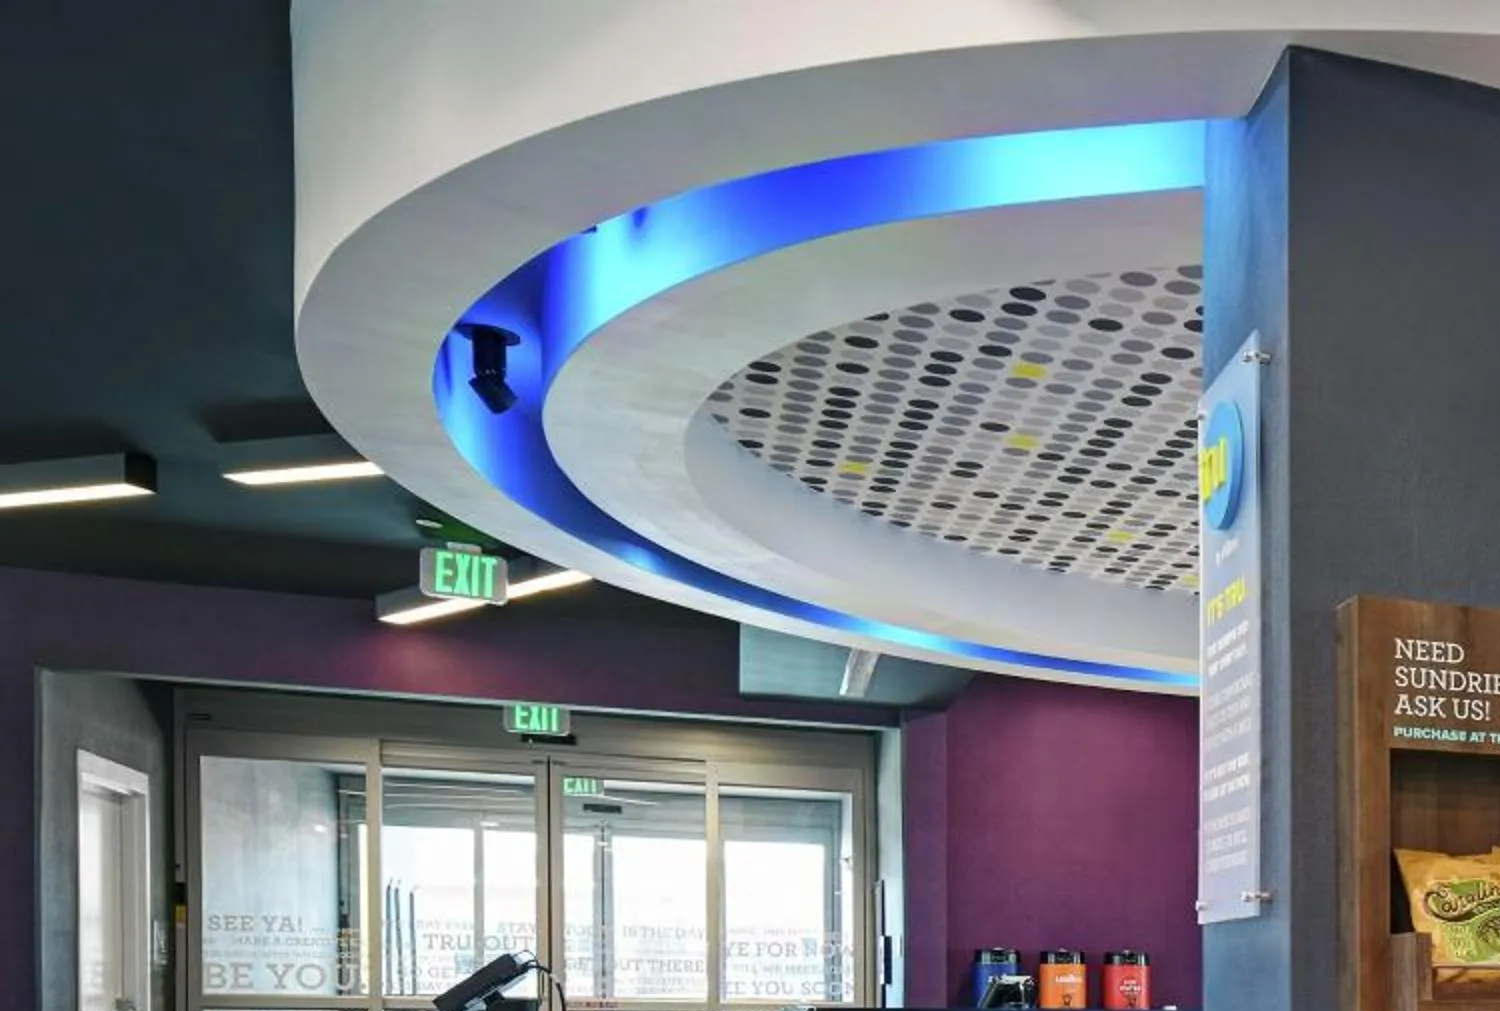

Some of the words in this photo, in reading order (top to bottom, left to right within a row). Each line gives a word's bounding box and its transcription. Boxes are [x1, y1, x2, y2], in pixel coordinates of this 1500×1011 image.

[435, 550, 498, 598] EXIT
[1394, 638, 1465, 664] NEED
[1394, 694, 1447, 718] ASK
[1452, 699, 1491, 721] US!
[1394, 727, 1467, 742] PURCHASE
[1469, 731, 1487, 742] AT
[208, 915, 254, 931] SEE
[262, 916, 303, 932] YA!
[756, 943, 798, 957] FOR
[651, 959, 705, 973] THERE
[206, 963, 254, 989] BE
[754, 981, 794, 996] YOU
